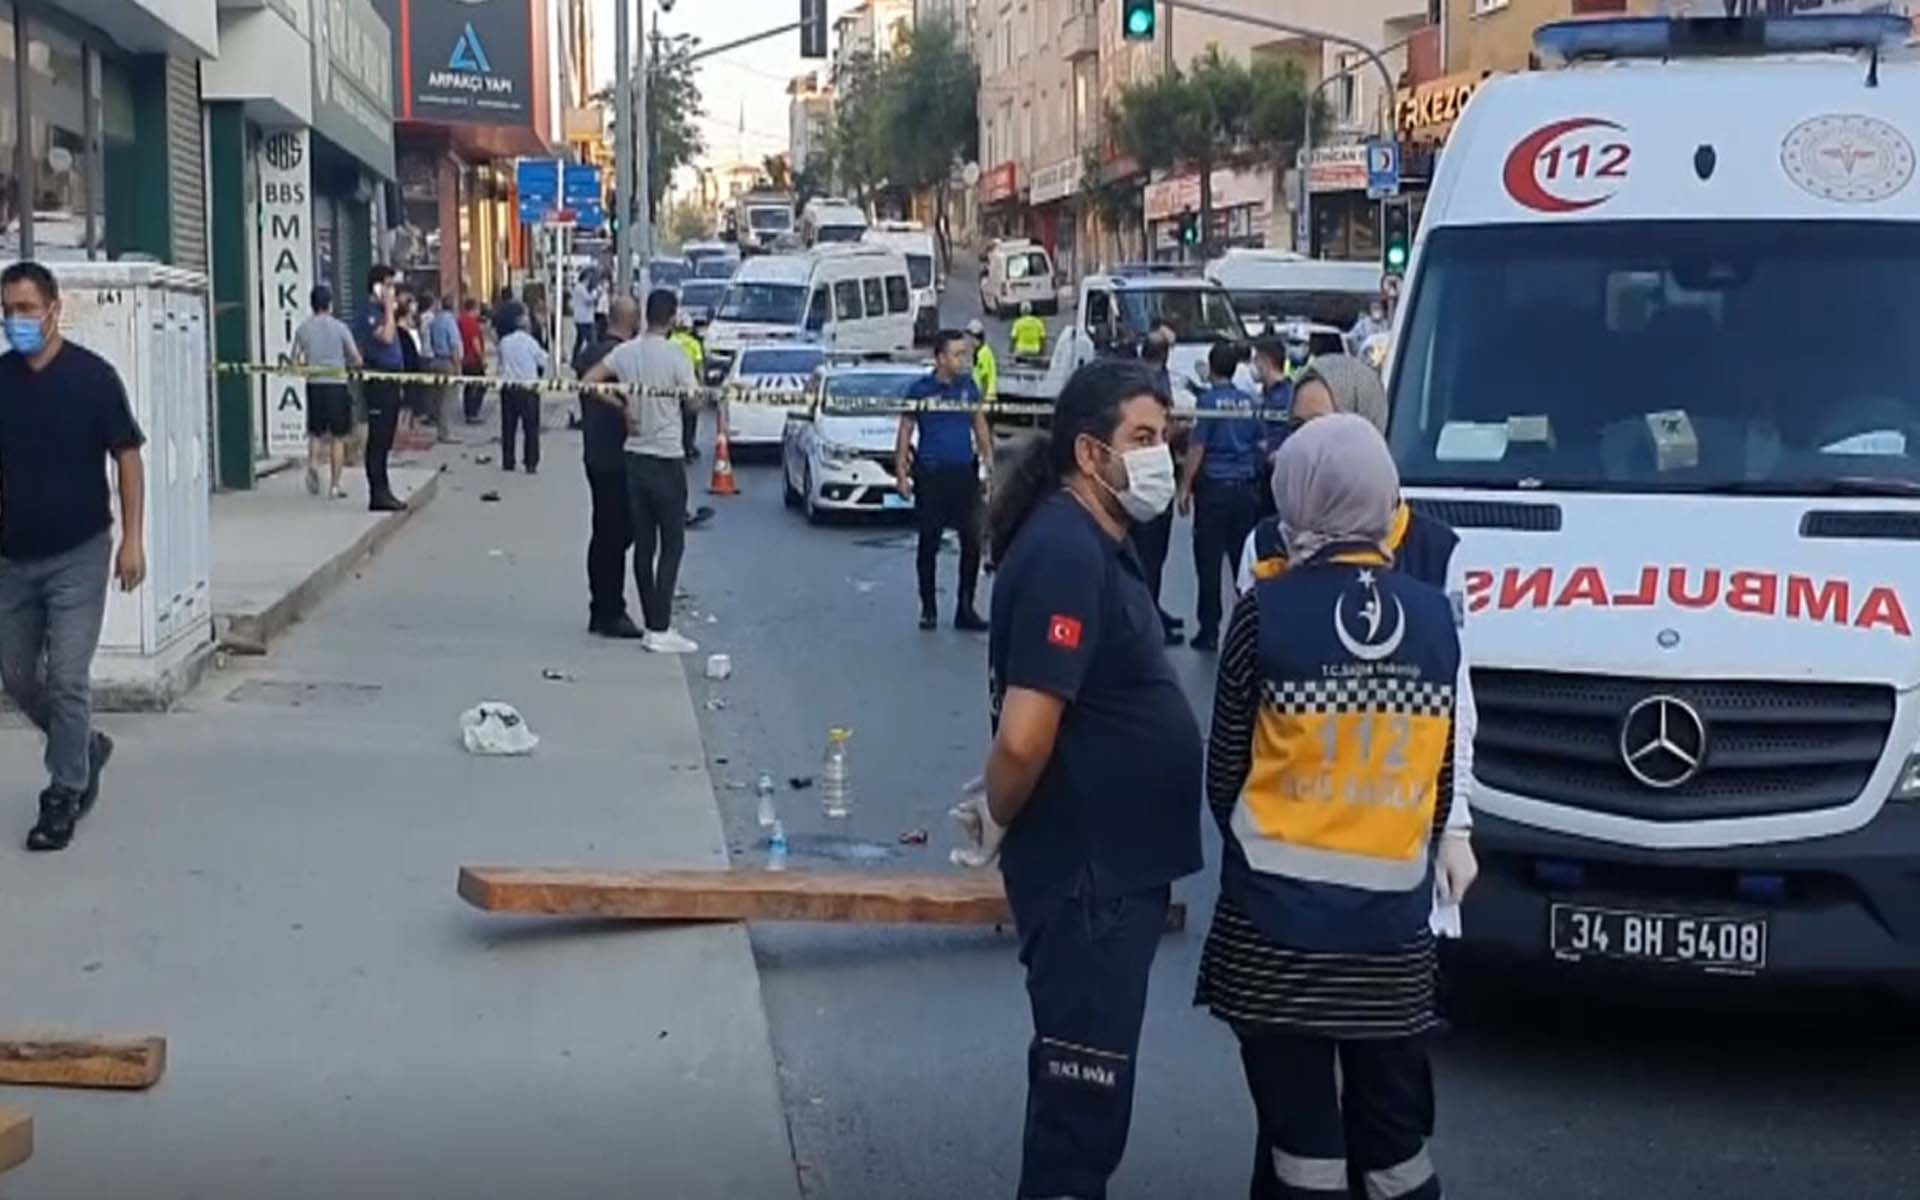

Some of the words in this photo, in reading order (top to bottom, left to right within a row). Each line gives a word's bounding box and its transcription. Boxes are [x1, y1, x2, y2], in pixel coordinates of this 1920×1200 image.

[1539, 143, 1632, 179] 112
[265, 182, 305, 204] BBS
[1315, 711, 1411, 771] 112
[1571, 913, 1609, 952] 34
[1624, 916, 1664, 956] BH
[1677, 920, 1759, 963] 5408
